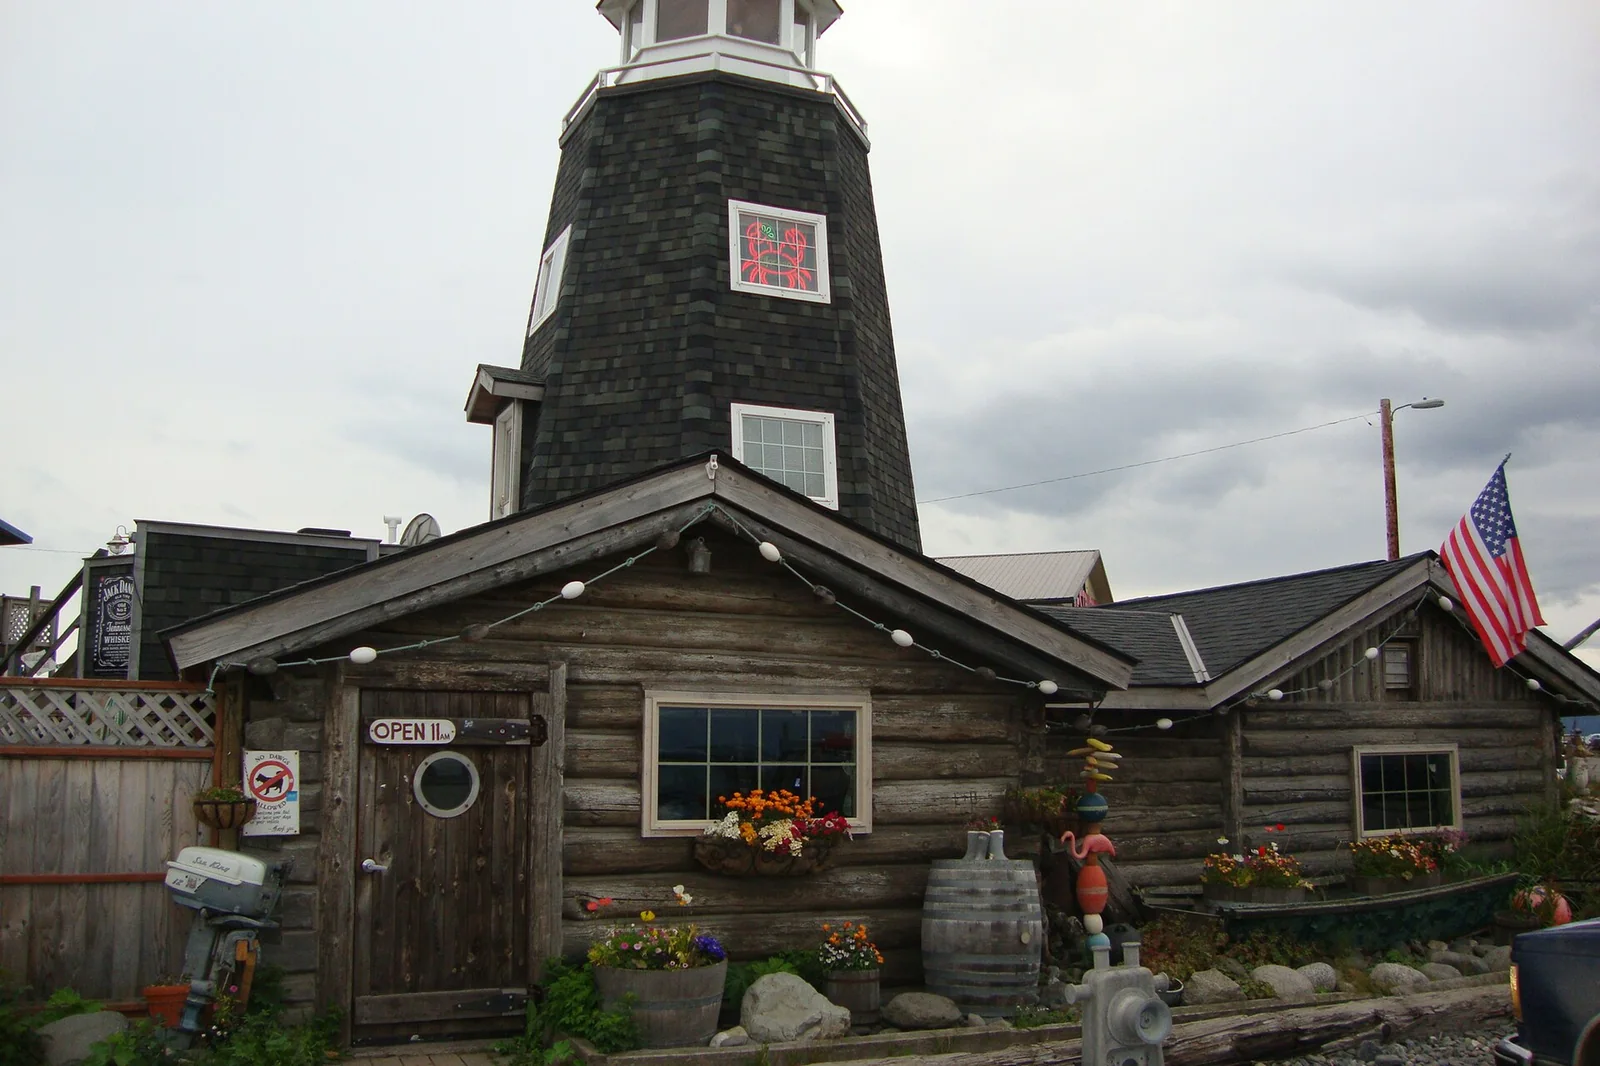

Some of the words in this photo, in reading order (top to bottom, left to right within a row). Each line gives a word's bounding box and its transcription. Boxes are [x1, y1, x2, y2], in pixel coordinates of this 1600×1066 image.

[103, 584, 119, 602] JACK
[374, 722, 426, 741] OPEN
[430, 722, 440, 741] 11
[255, 754, 265, 763] NO
[269, 753, 291, 766] DAWGS
[256, 800, 287, 810] ALLOWED
[192, 856, 207, 866] Sea
[209, 861, 231, 873] King
